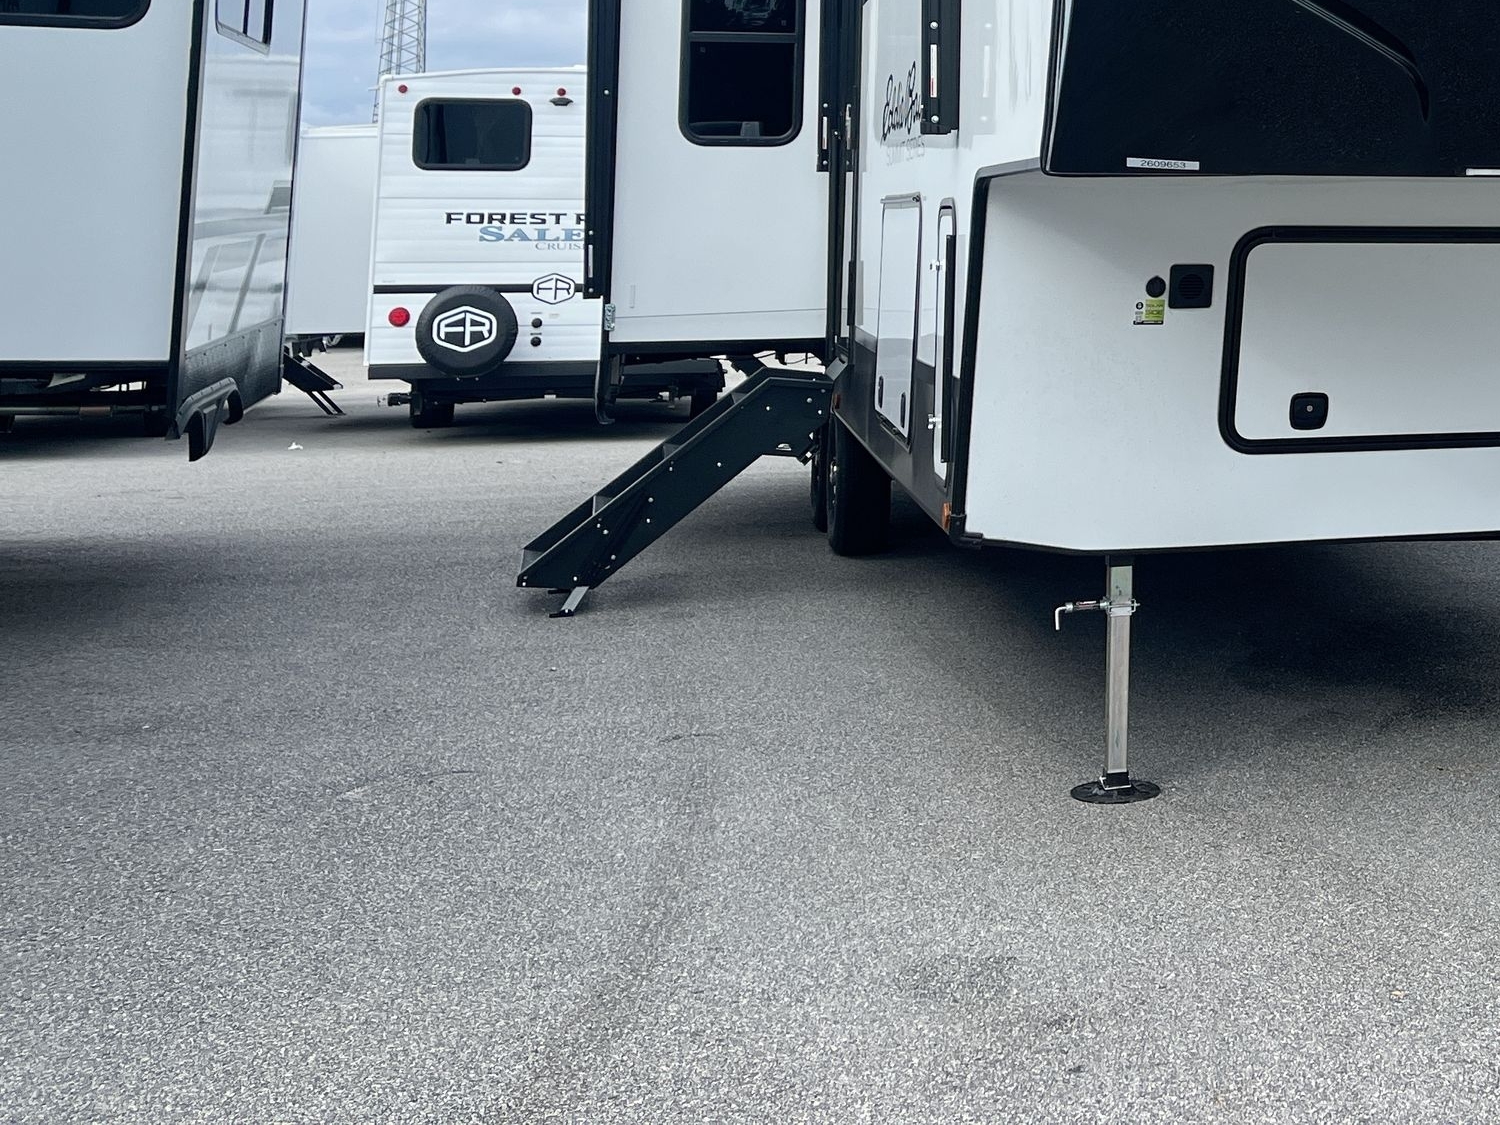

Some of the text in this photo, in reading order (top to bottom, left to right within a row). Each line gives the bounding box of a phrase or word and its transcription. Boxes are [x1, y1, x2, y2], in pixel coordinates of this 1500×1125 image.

[1140, 160, 1186, 168] 2609653
[445, 212, 567, 225] FOREST
[479, 226, 586, 242] SALE
[535, 242, 586, 251] CRUIS
